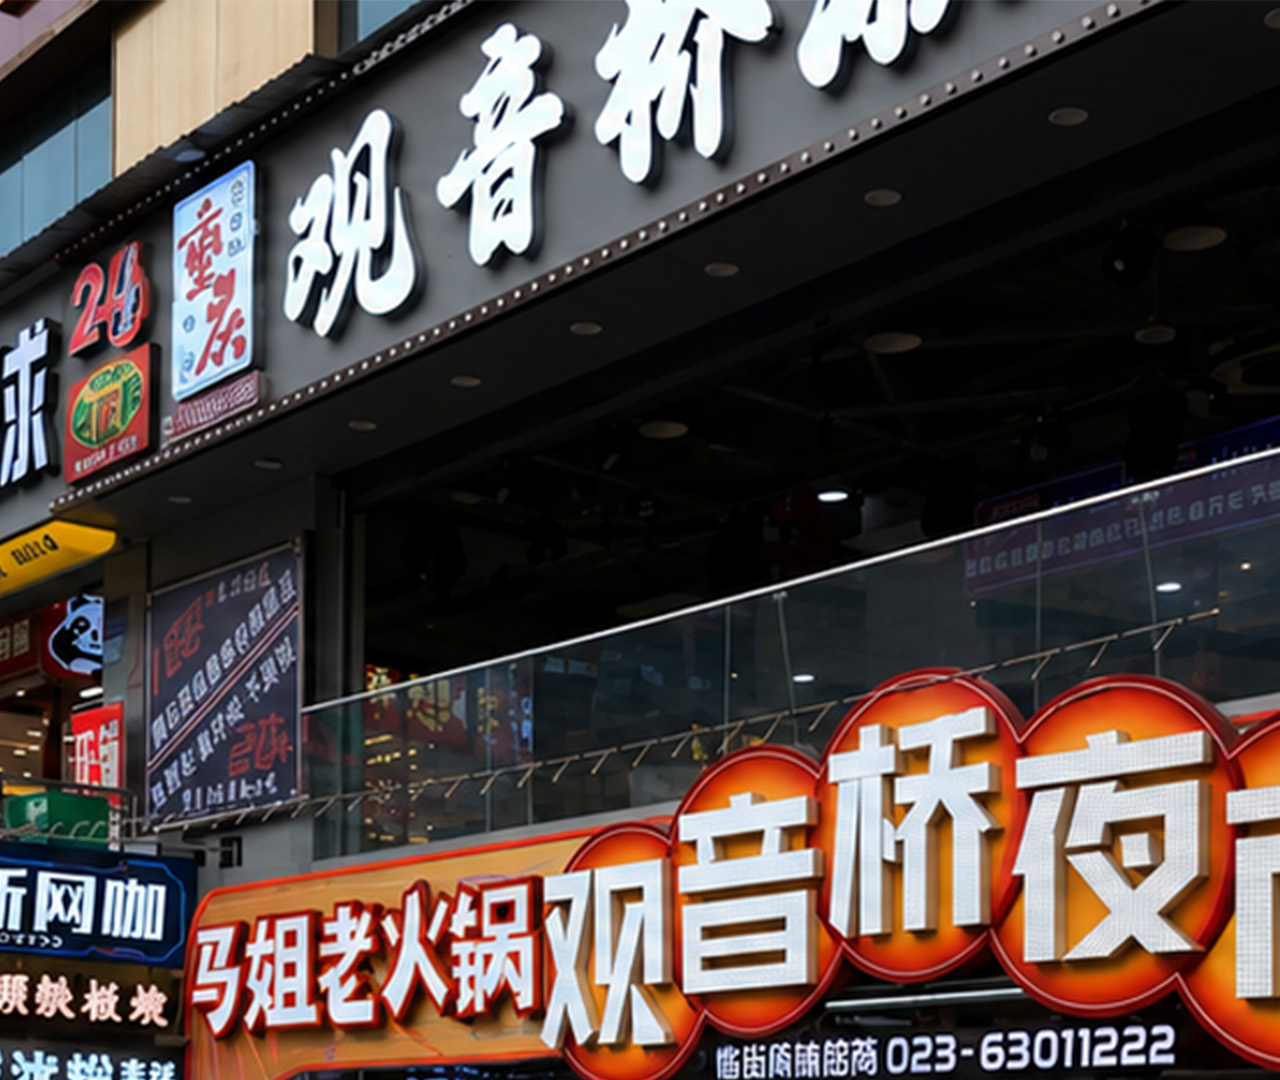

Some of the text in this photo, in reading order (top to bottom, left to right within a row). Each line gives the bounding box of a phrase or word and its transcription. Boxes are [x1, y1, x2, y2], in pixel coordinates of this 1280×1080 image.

[191, 882, 536, 1036] 马姐老火锅
[885, 1024, 1176, 1074] 023-63011222
